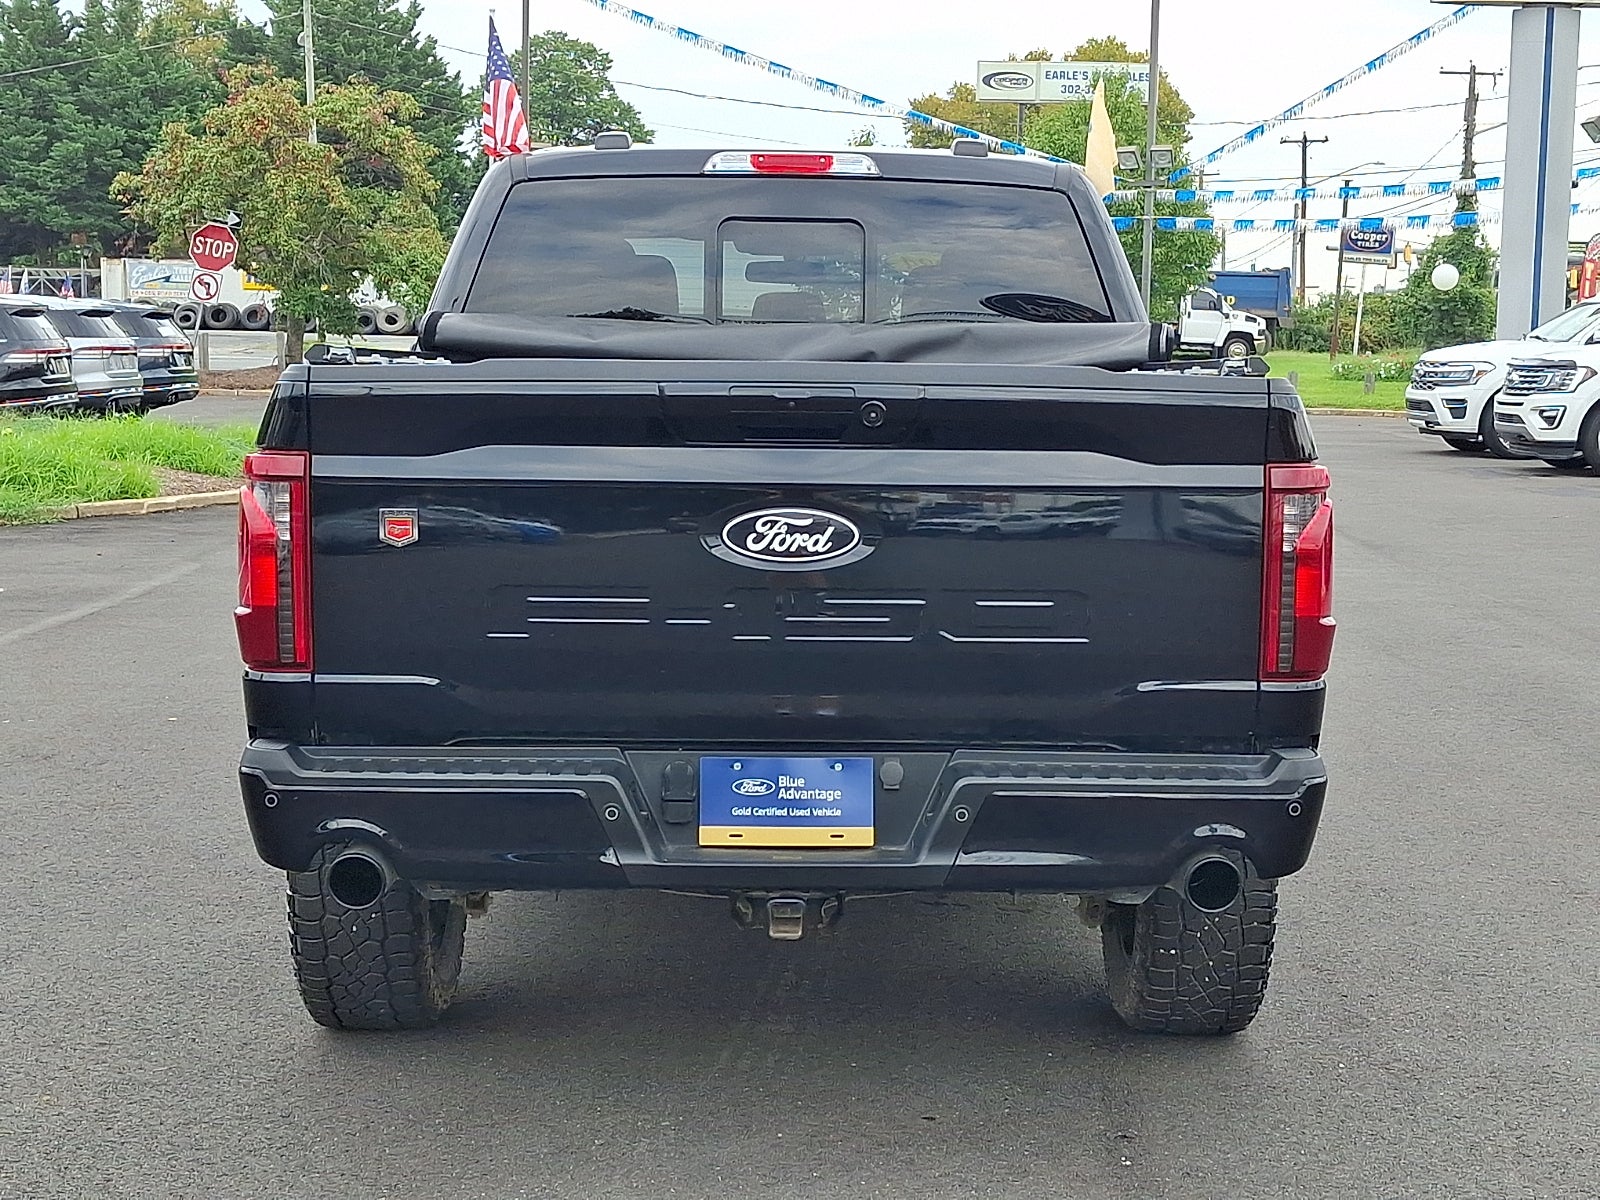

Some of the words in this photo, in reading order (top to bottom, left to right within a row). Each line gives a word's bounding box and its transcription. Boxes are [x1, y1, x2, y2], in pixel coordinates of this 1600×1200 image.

[1045, 70, 1089, 81] EARLE'S
[1350, 230, 1388, 242] Cooper
[193, 236, 234, 259] STOP
[745, 515, 835, 553] Ford
[740, 780, 768, 794] Ford
[778, 775, 805, 788] Blue
[778, 787, 842, 801] Advantage
[731, 806, 751, 816] Gold
[752, 806, 788, 816] Certified
[789, 807, 811, 817] Used
[812, 807, 842, 817] Vehicle
